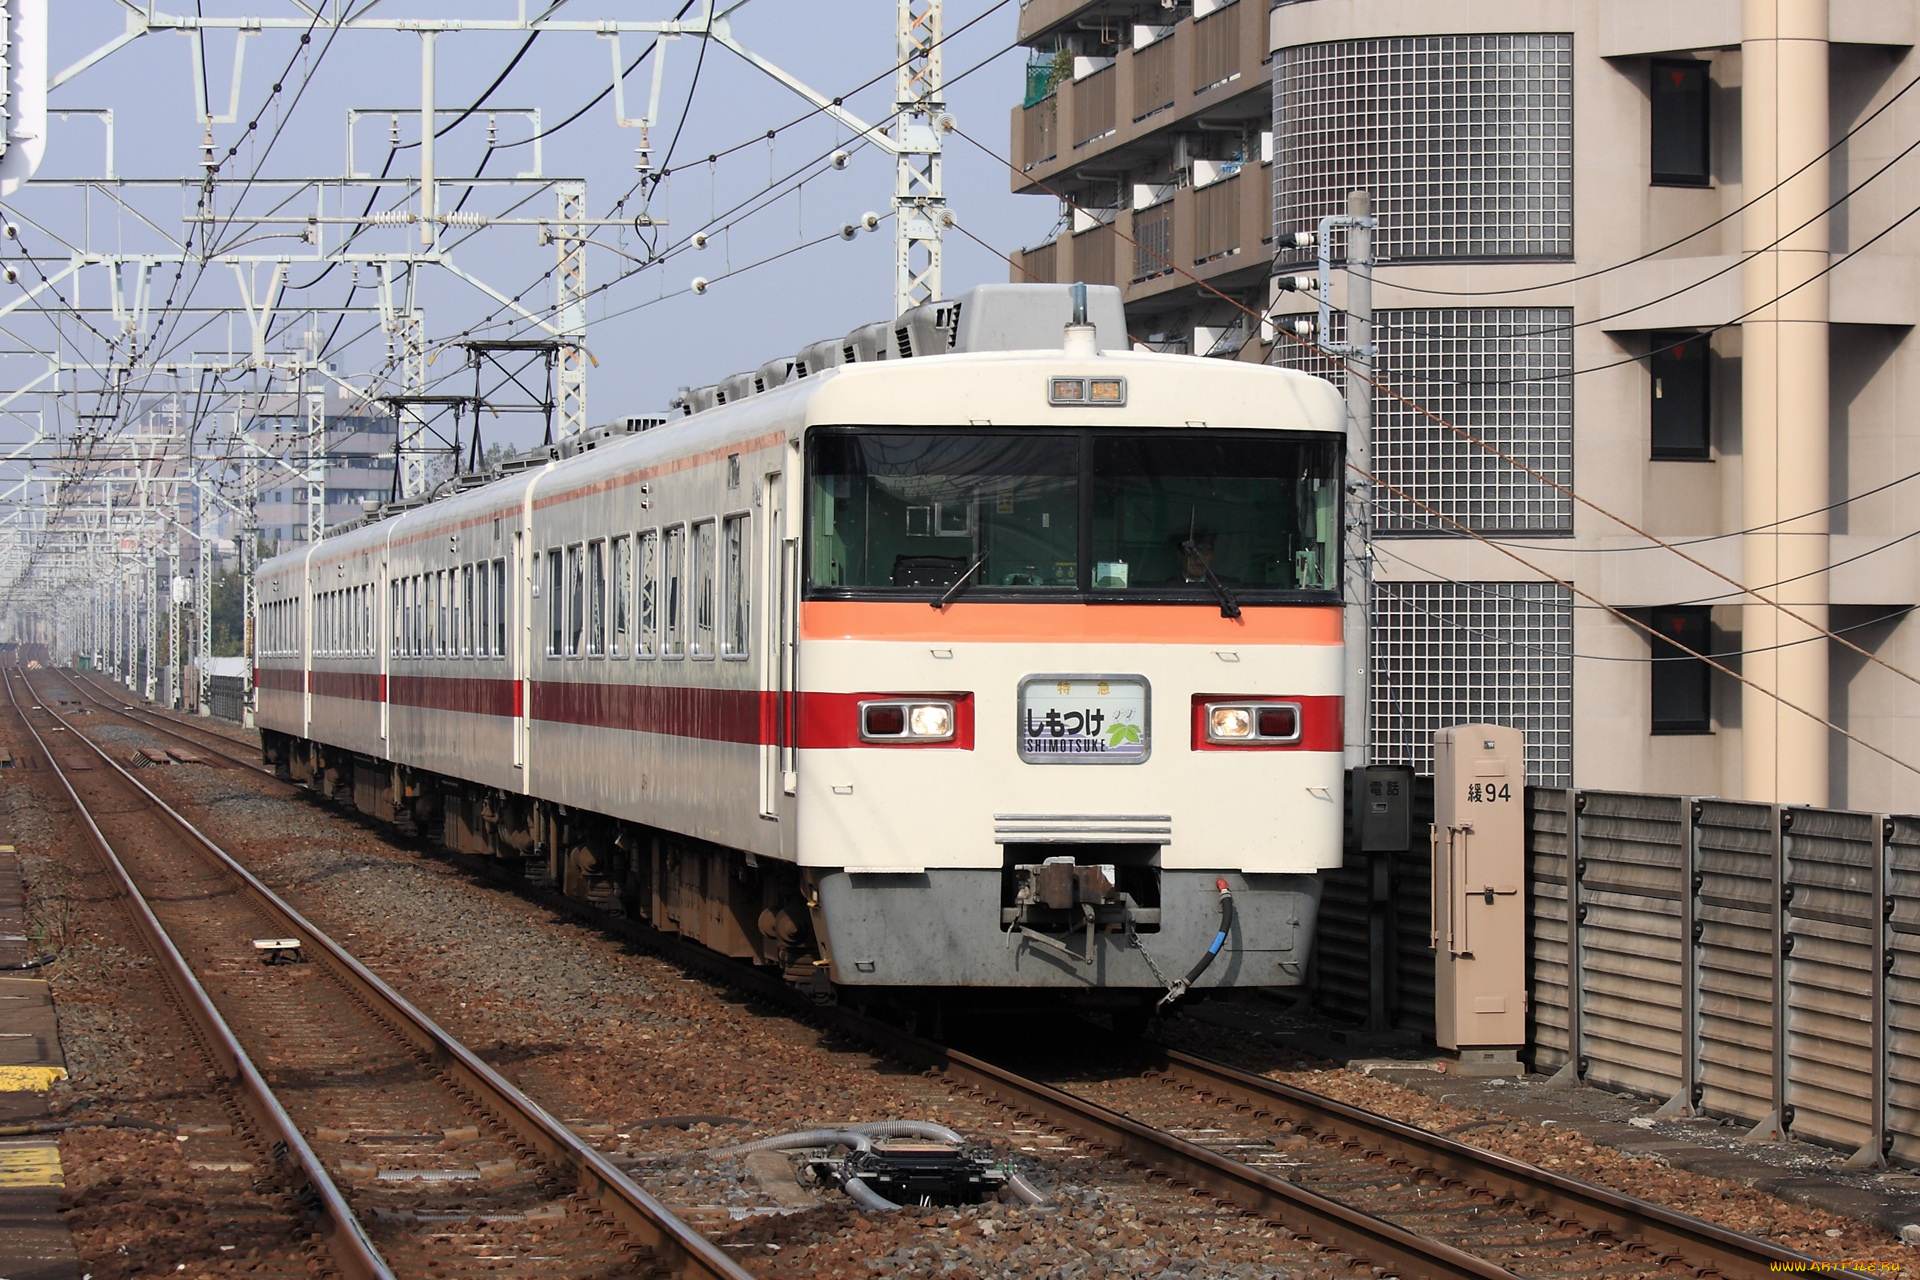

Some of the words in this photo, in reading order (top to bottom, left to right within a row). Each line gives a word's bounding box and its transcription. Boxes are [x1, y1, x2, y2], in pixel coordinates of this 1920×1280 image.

[1057, 681, 1110, 695] 特急
[1027, 708, 1104, 737] しもつけ
[1027, 738, 1106, 753] SHIMOTSUKE
[1370, 781, 1399, 796] 電話
[1467, 783, 1511, 803] 緩94
